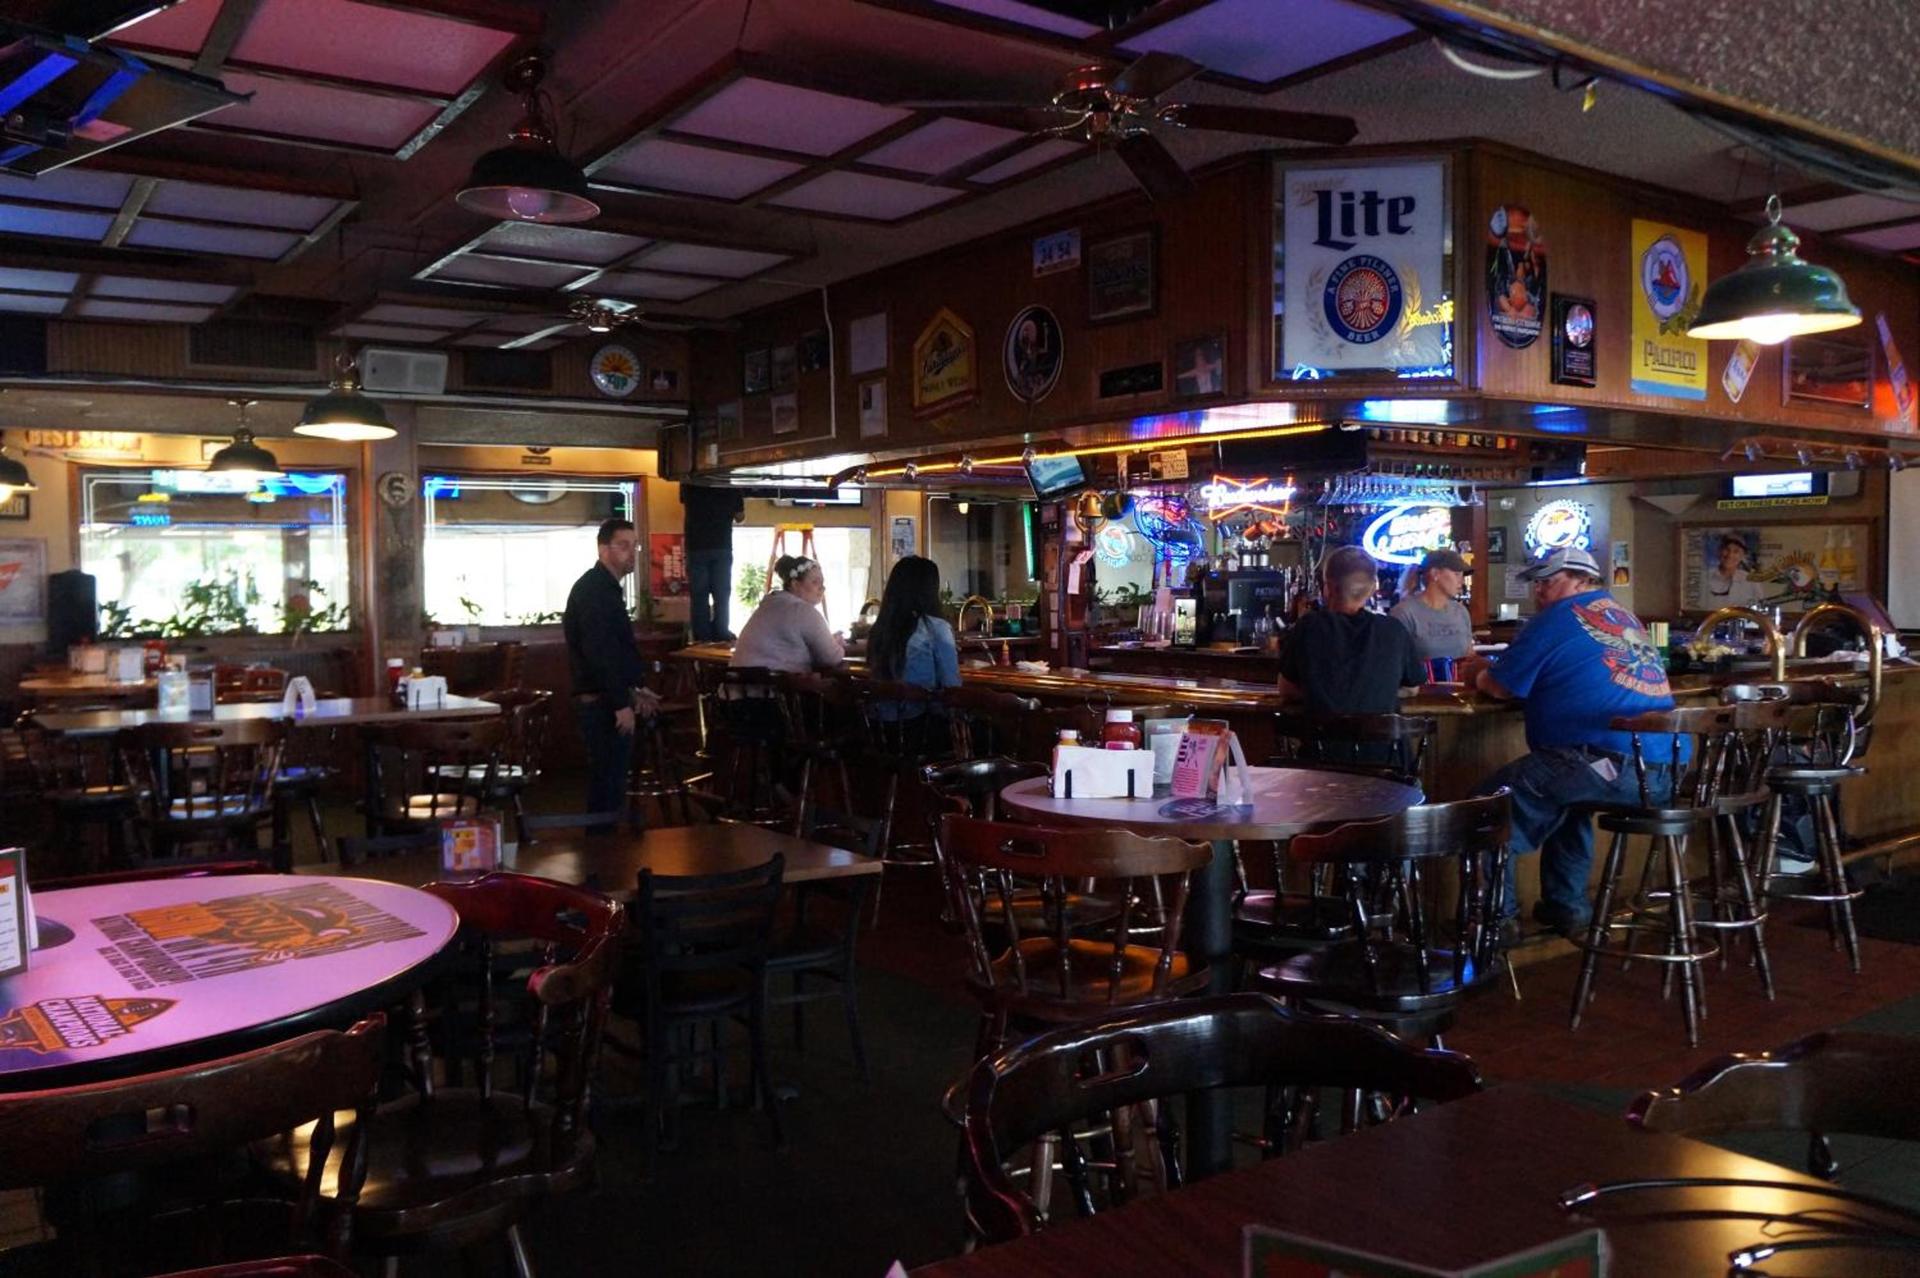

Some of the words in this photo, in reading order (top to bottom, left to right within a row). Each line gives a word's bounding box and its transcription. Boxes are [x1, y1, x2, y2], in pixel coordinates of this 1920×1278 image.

[1312, 190, 1416, 251] Lite
[1332, 258, 1357, 284] FINE
[1360, 257, 1400, 293] PILSNER
[1347, 331, 1379, 342] BEER
